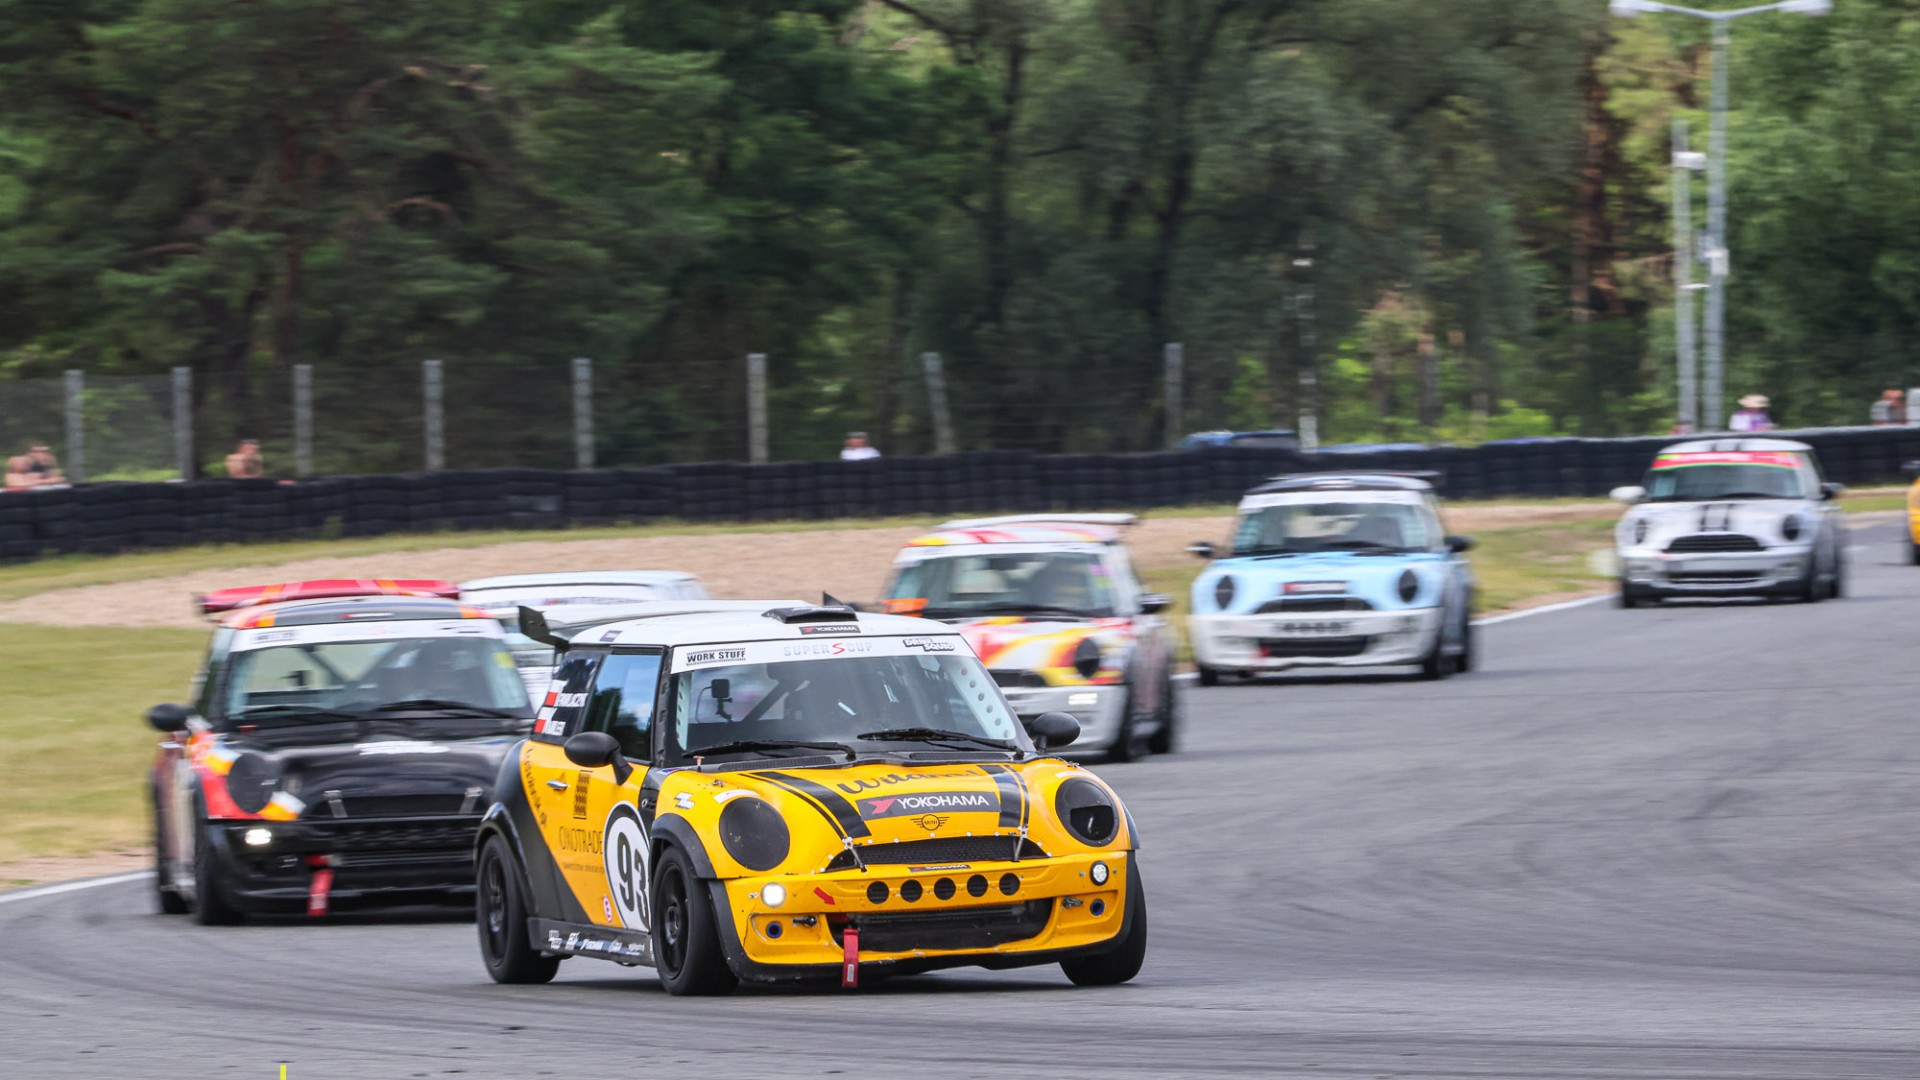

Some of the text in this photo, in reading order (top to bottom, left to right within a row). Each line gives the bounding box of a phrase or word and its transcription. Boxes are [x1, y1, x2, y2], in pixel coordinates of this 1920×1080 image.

[687, 651, 746, 663] WORK STUFF
[897, 795, 990, 810] YOKOHAMA
[617, 831, 651, 931] 93
